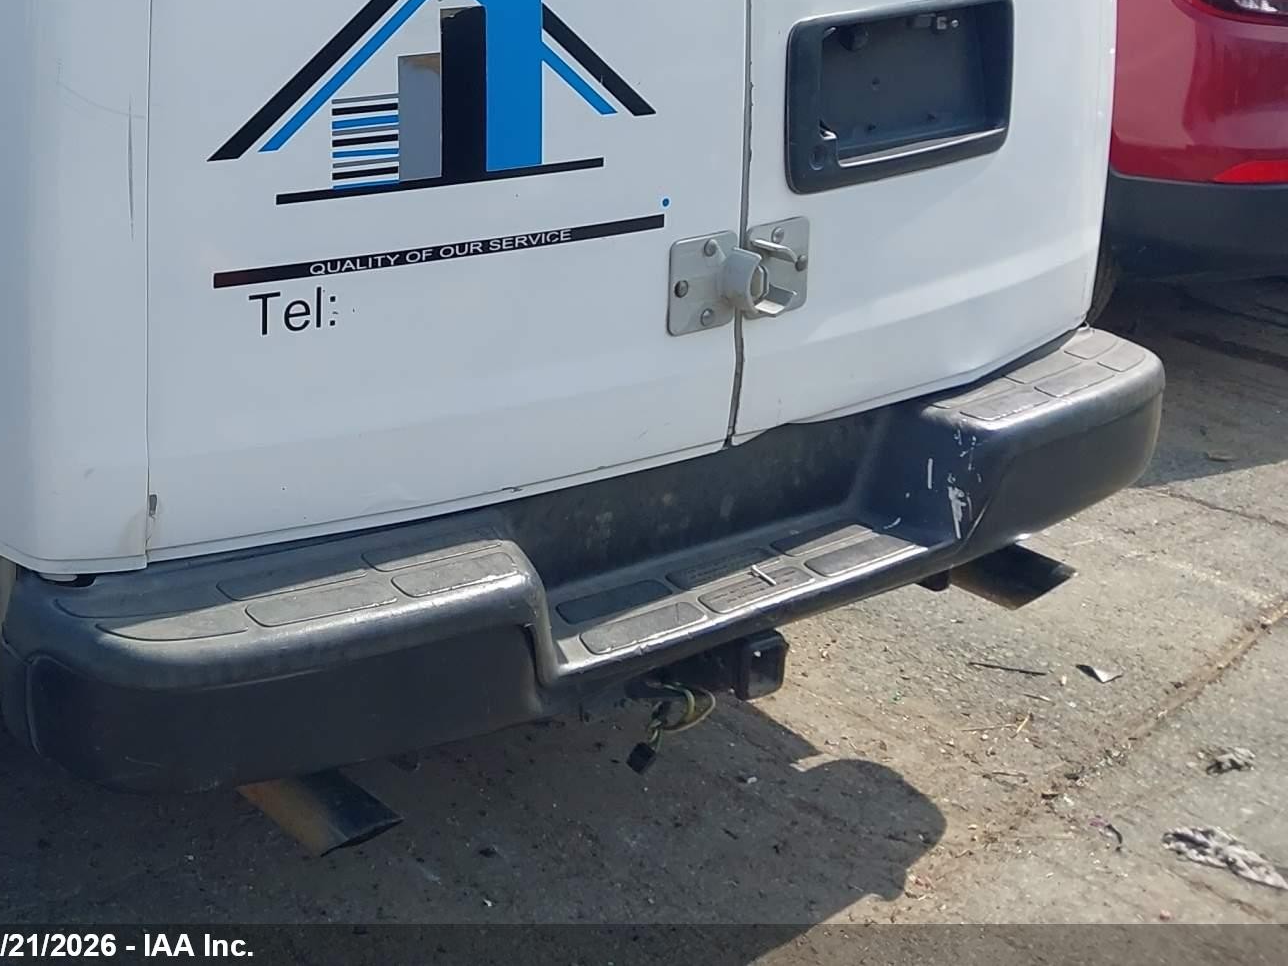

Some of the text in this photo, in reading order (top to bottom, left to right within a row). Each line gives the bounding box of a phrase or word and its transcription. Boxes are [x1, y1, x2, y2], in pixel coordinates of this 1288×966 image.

[309, 228, 572, 275] QUALITY OF OUR SERVICE
[248, 286, 337, 336] Tel:
